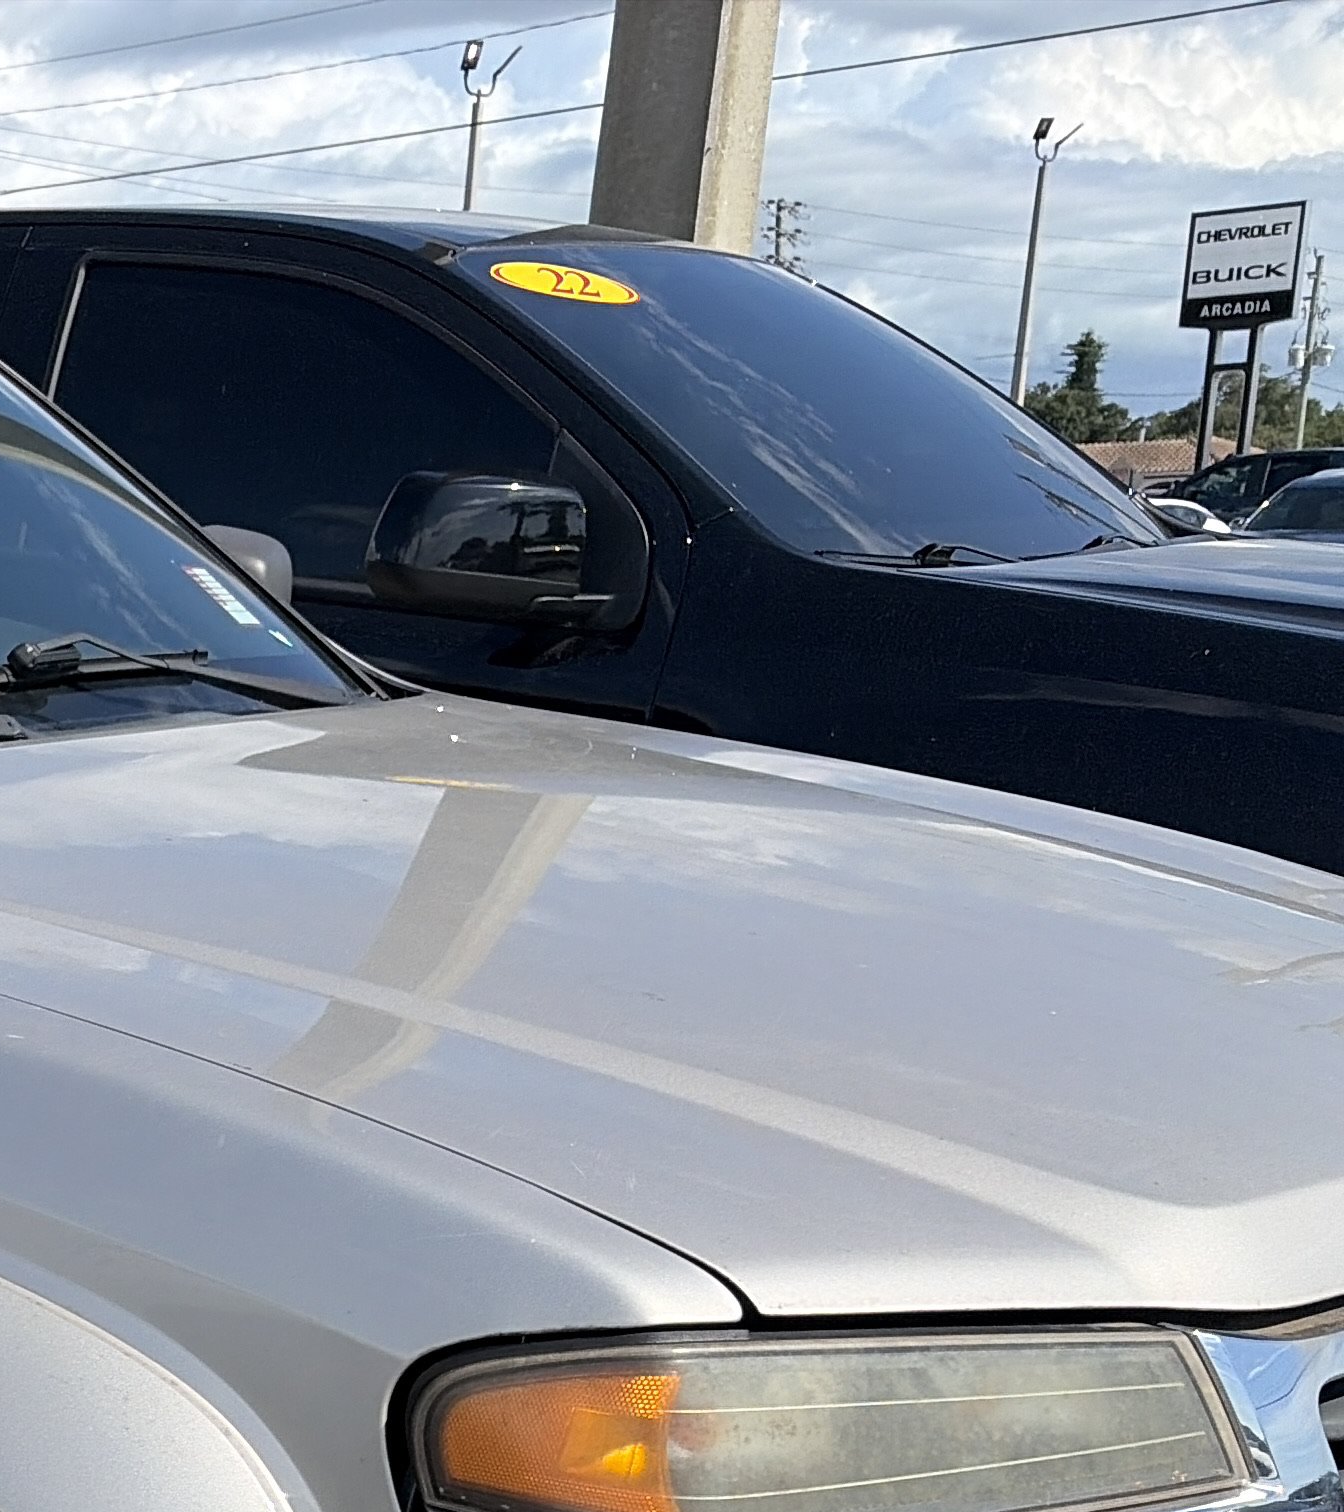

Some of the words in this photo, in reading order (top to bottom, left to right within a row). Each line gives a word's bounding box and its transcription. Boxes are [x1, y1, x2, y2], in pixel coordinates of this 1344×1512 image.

[1196, 221, 1293, 245] CHEVROLET
[536, 267, 602, 298] 22
[1191, 262, 1288, 285] BUICK
[1199, 299, 1272, 318] ARCADIA
